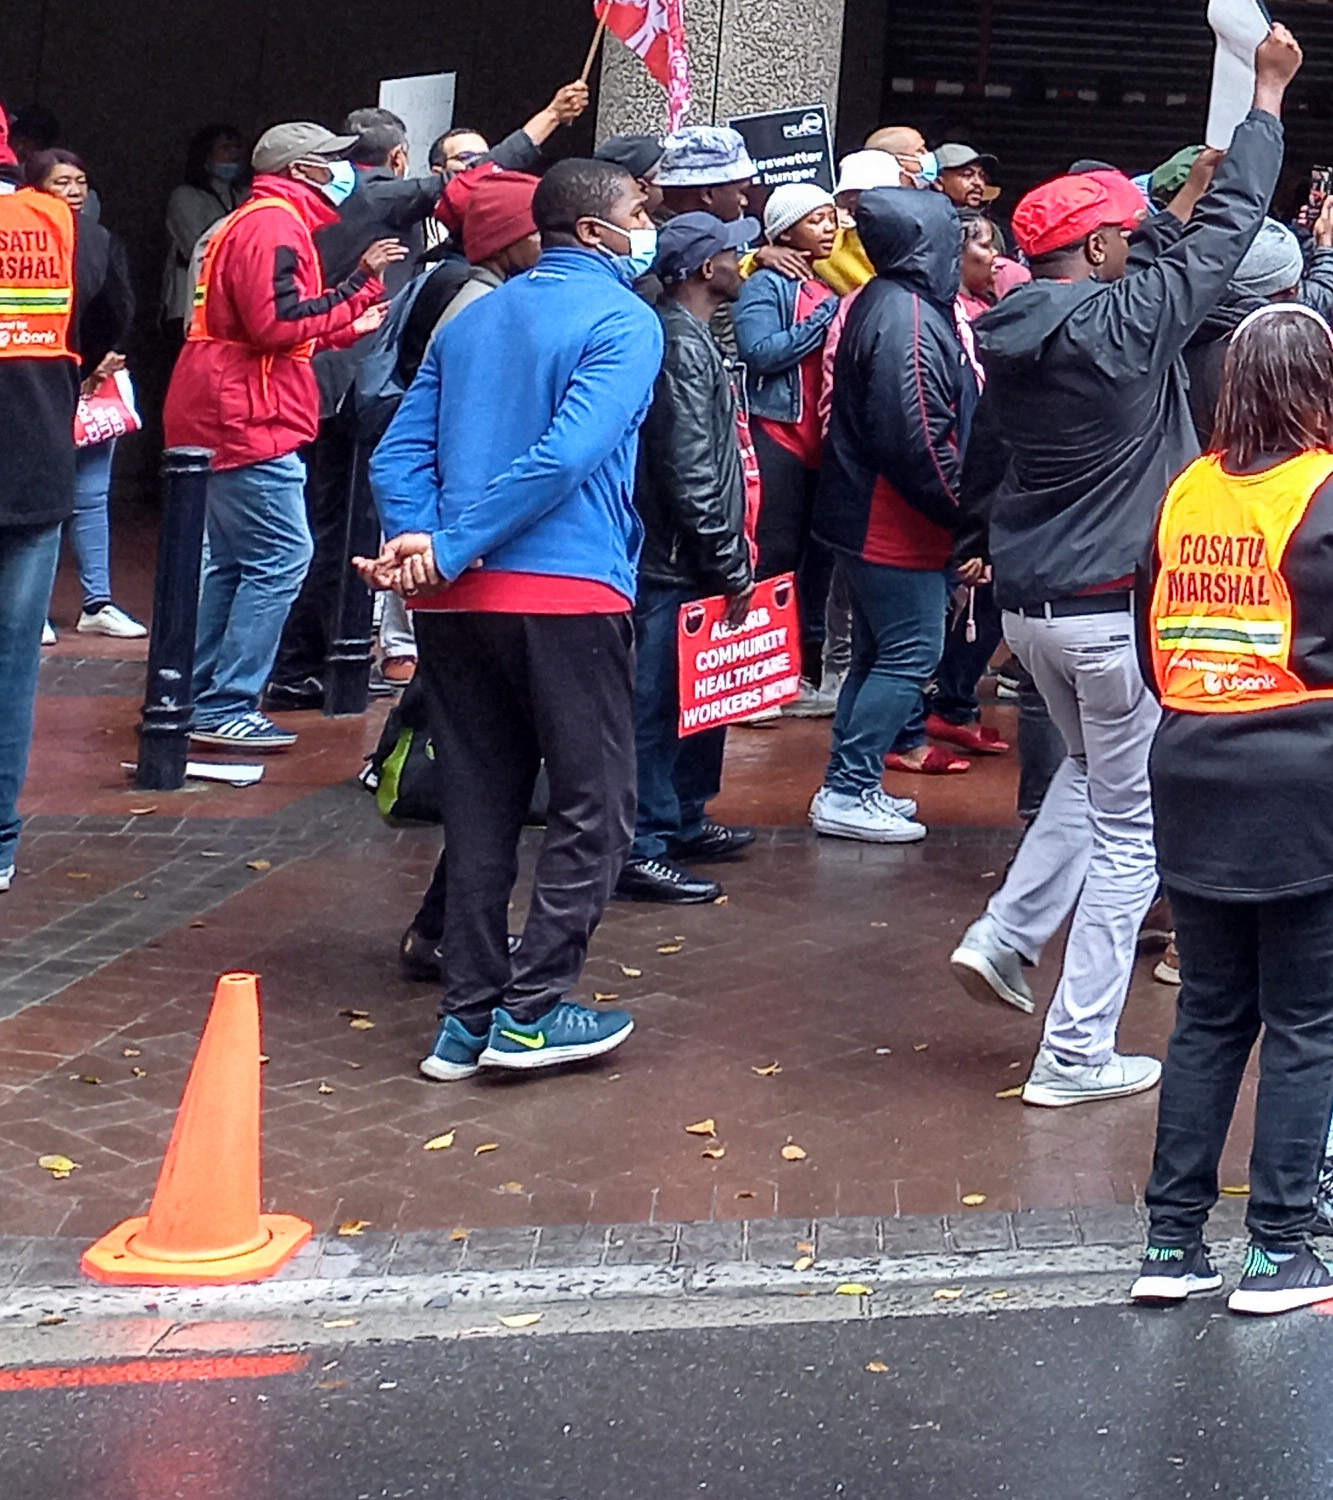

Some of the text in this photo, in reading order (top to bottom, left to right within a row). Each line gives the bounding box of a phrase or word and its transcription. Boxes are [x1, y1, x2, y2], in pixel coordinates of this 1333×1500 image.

[0, 230, 48, 251] SATU
[0, 255, 60, 280] SHAL
[1180, 534, 1266, 568] COSATU
[1167, 570, 1271, 607] MARSHAL
[710, 607, 771, 642] ABRB
[695, 627, 788, 672] COMMUNITY
[694, 652, 791, 700] HEALTHCARE
[683, 688, 762, 729] WORKERS
